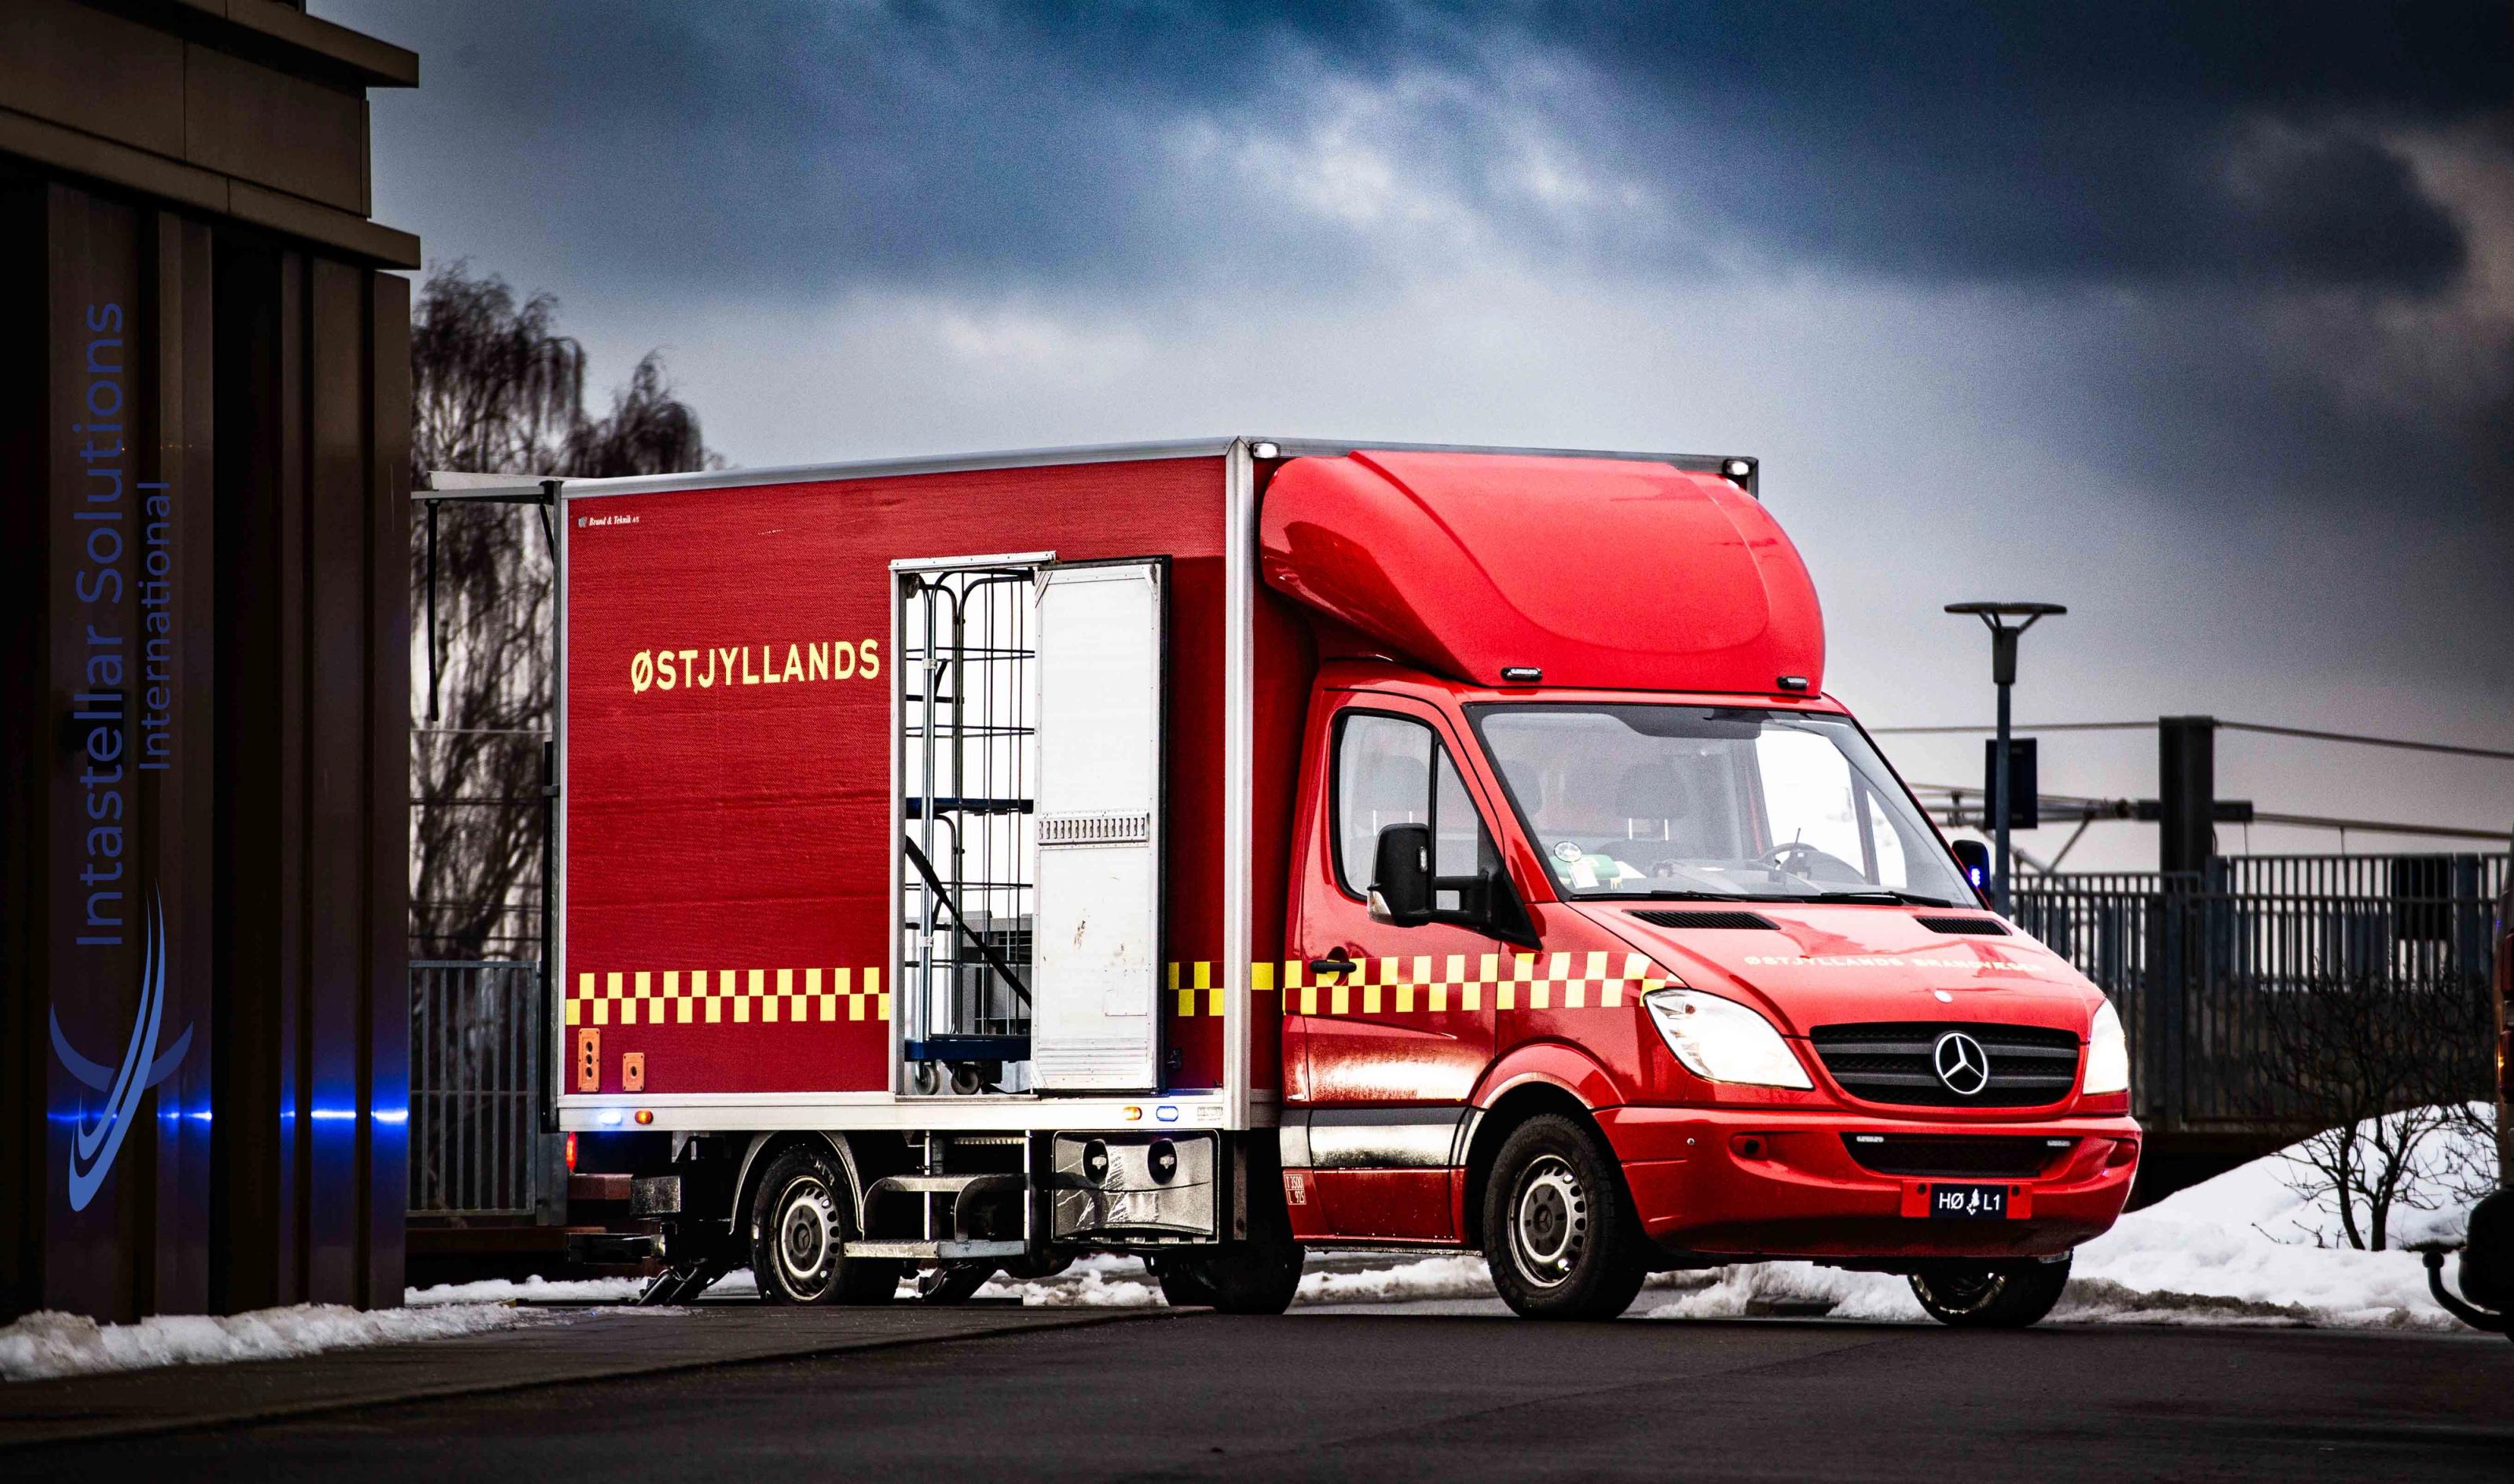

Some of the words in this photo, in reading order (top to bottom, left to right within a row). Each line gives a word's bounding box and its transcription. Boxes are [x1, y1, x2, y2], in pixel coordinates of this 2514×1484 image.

[589, 516, 607, 526] Brand
[631, 639, 880, 694] ØSTJYLLANDS
[1938, 1192, 1965, 1210] HØ
[1983, 1193, 2001, 1211] L1
